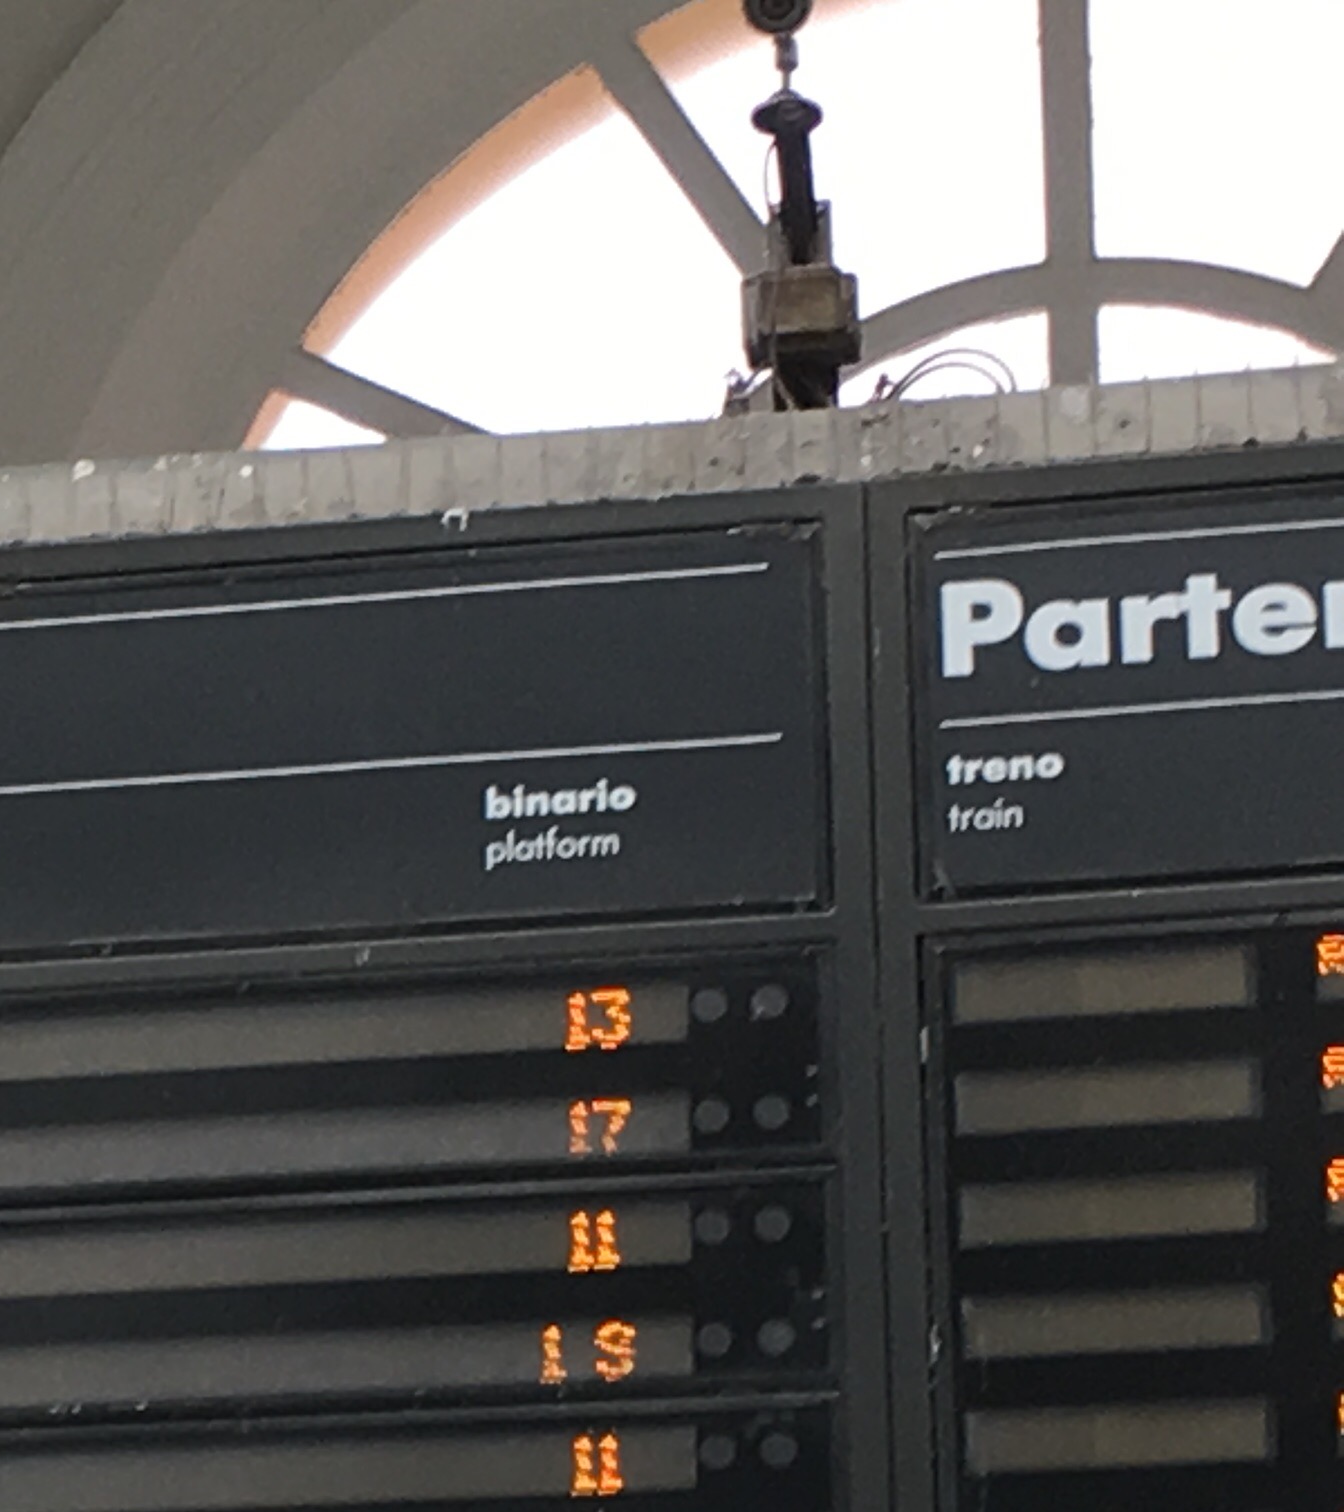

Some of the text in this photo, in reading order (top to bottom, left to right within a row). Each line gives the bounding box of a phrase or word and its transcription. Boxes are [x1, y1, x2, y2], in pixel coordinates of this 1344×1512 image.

[941, 573, 1344, 678] Parte
[946, 753, 1064, 785] treno
[486, 778, 636, 819] binario
[948, 797, 1024, 832] train
[486, 825, 620, 871] platform
[564, 987, 632, 1052] 13
[568, 1099, 632, 1154] 17
[567, 1209, 622, 1273] 11
[540, 1324, 568, 1384] 1
[571, 1434, 624, 1497] 11
